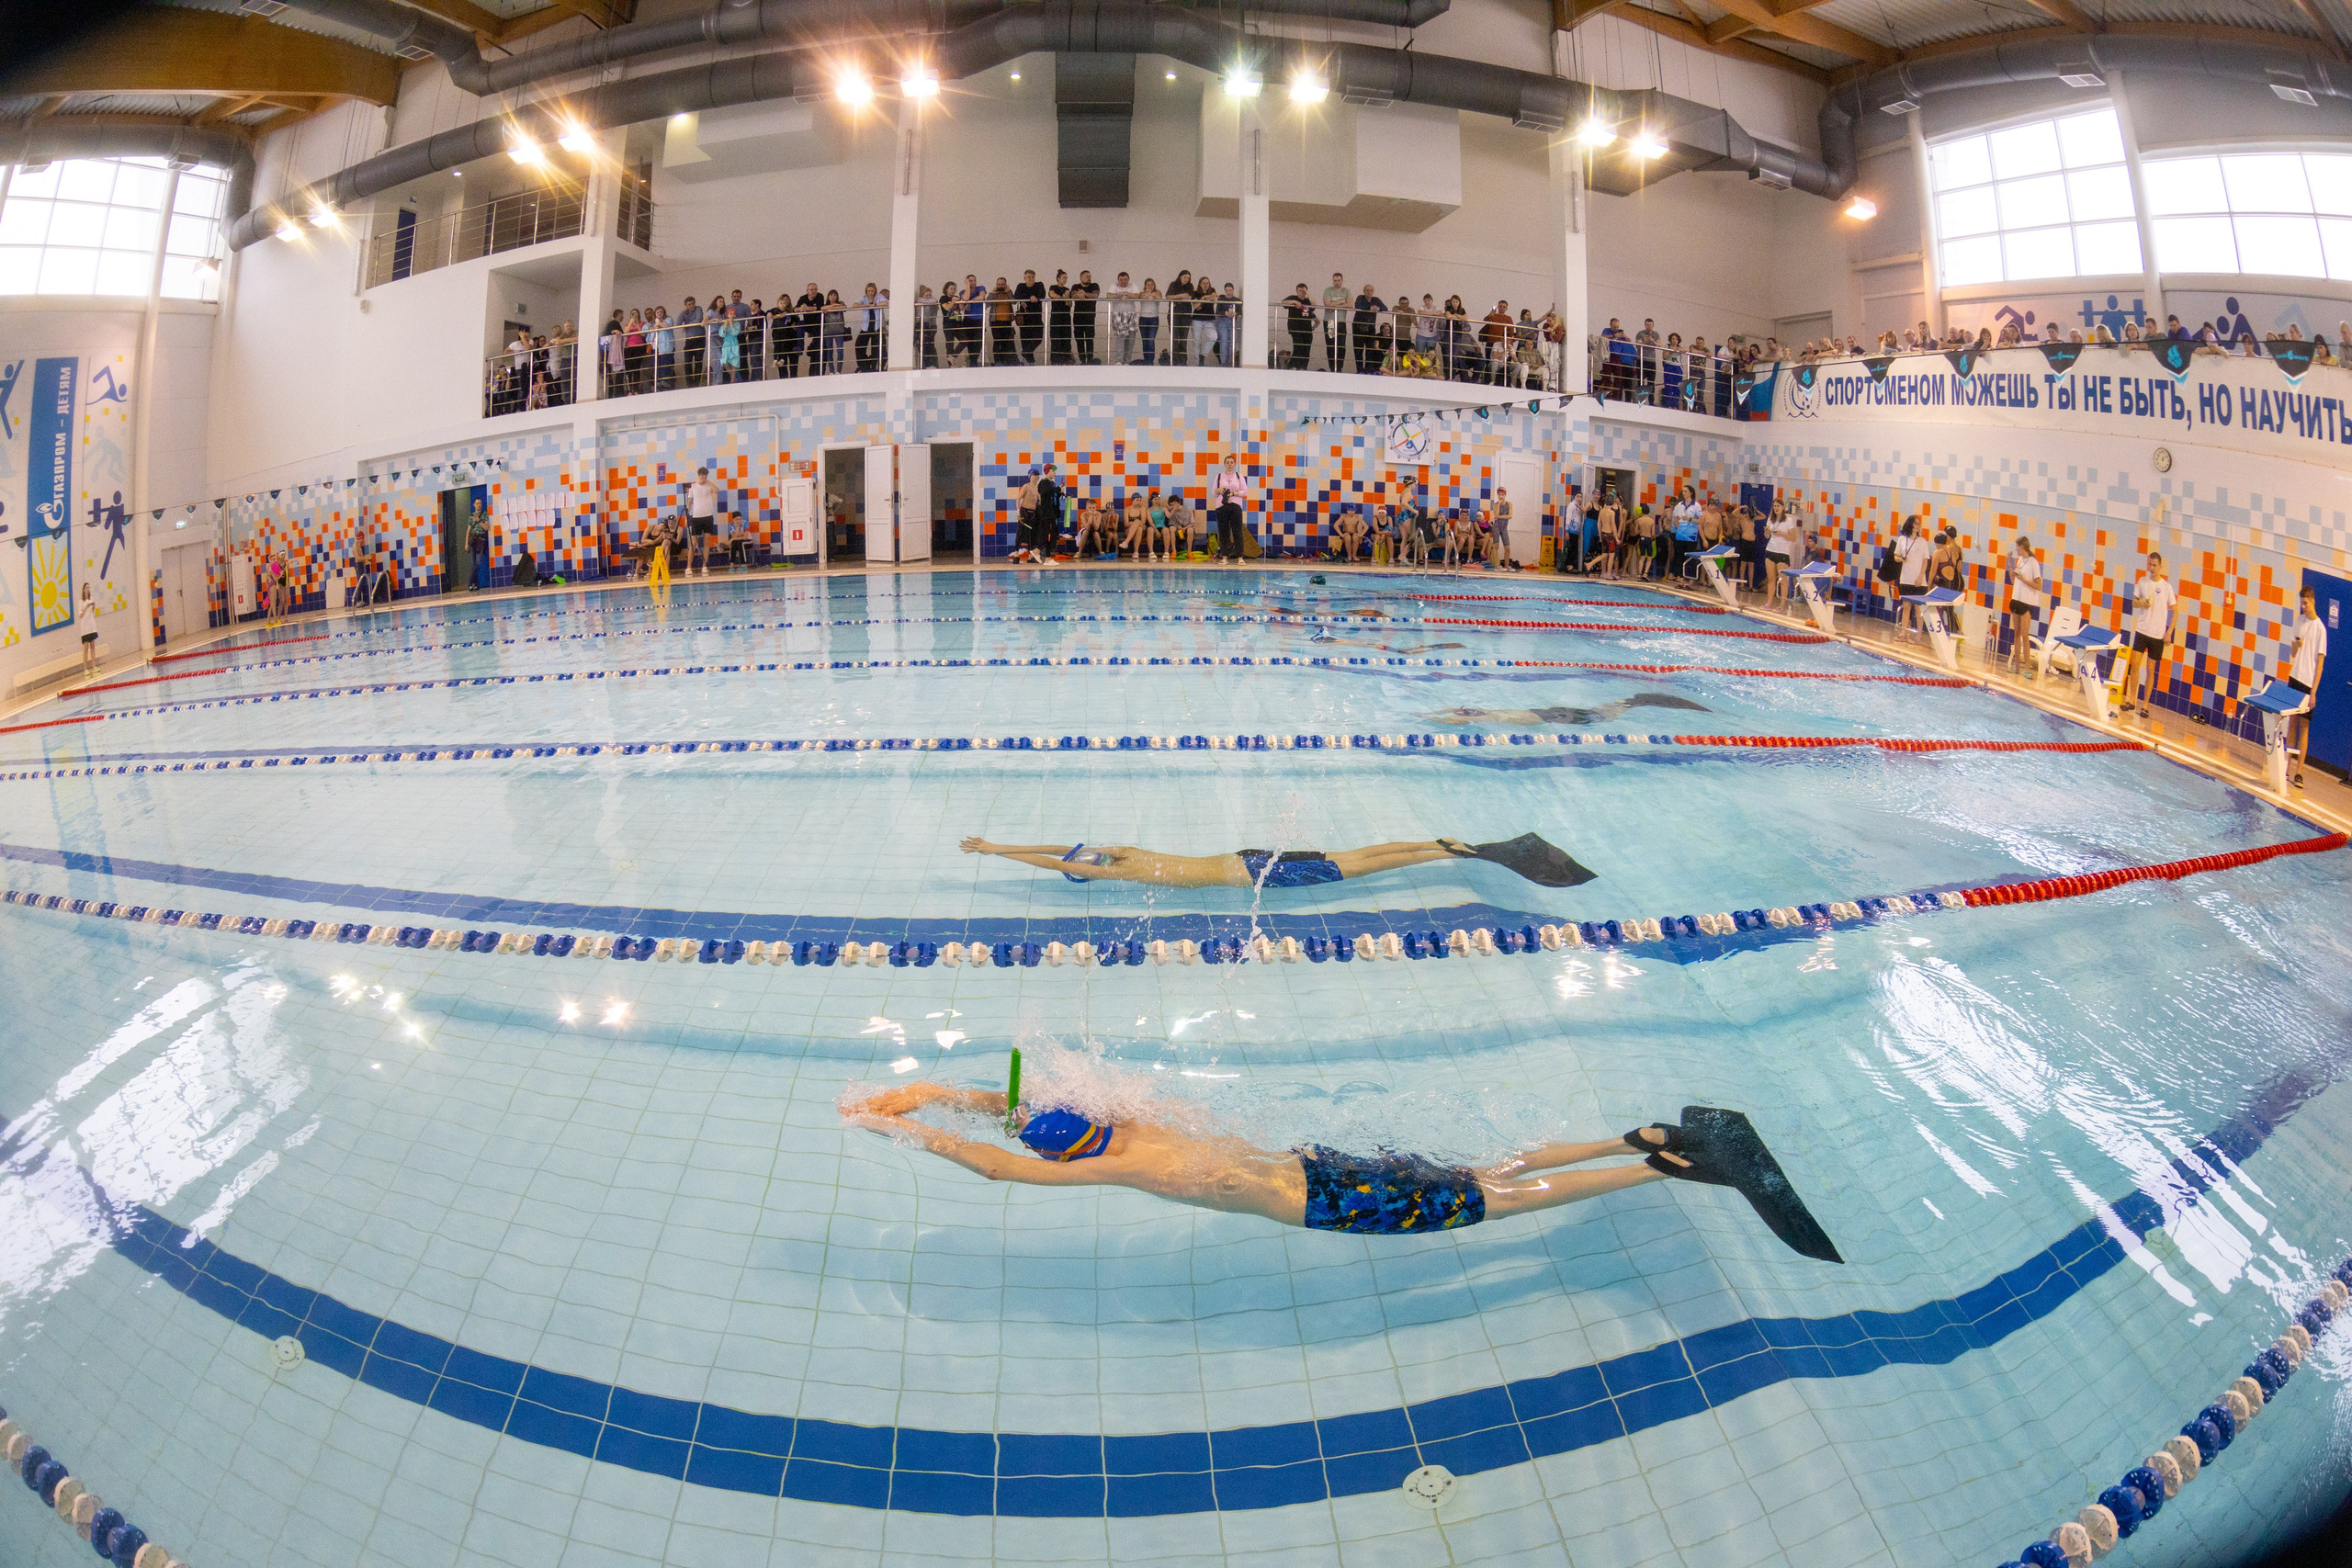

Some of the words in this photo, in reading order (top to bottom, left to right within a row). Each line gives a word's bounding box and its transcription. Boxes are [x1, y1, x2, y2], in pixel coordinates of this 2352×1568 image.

[57, 367, 72, 414] ДЕТЯМ
[1825, 374, 1945, 406] СПОРТСМЕНОМ
[1951, 373, 2039, 409] МОЖЕШЬ
[2044, 374, 2075, 411] ТЫ
[2083, 375, 2112, 413] НЕ
[2119, 377, 2192, 432] БЫТЬ,
[2199, 382, 2233, 426] НО
[2240, 386, 2352, 446] НАУЧИТЬ
[53, 433, 66, 499] ГАЗПРОМ
[1714, 569, 1721, 580] 1
[1813, 590, 1819, 602] 2
[1936, 620, 1942, 634] 3
[2090, 667, 2097, 682] 4
